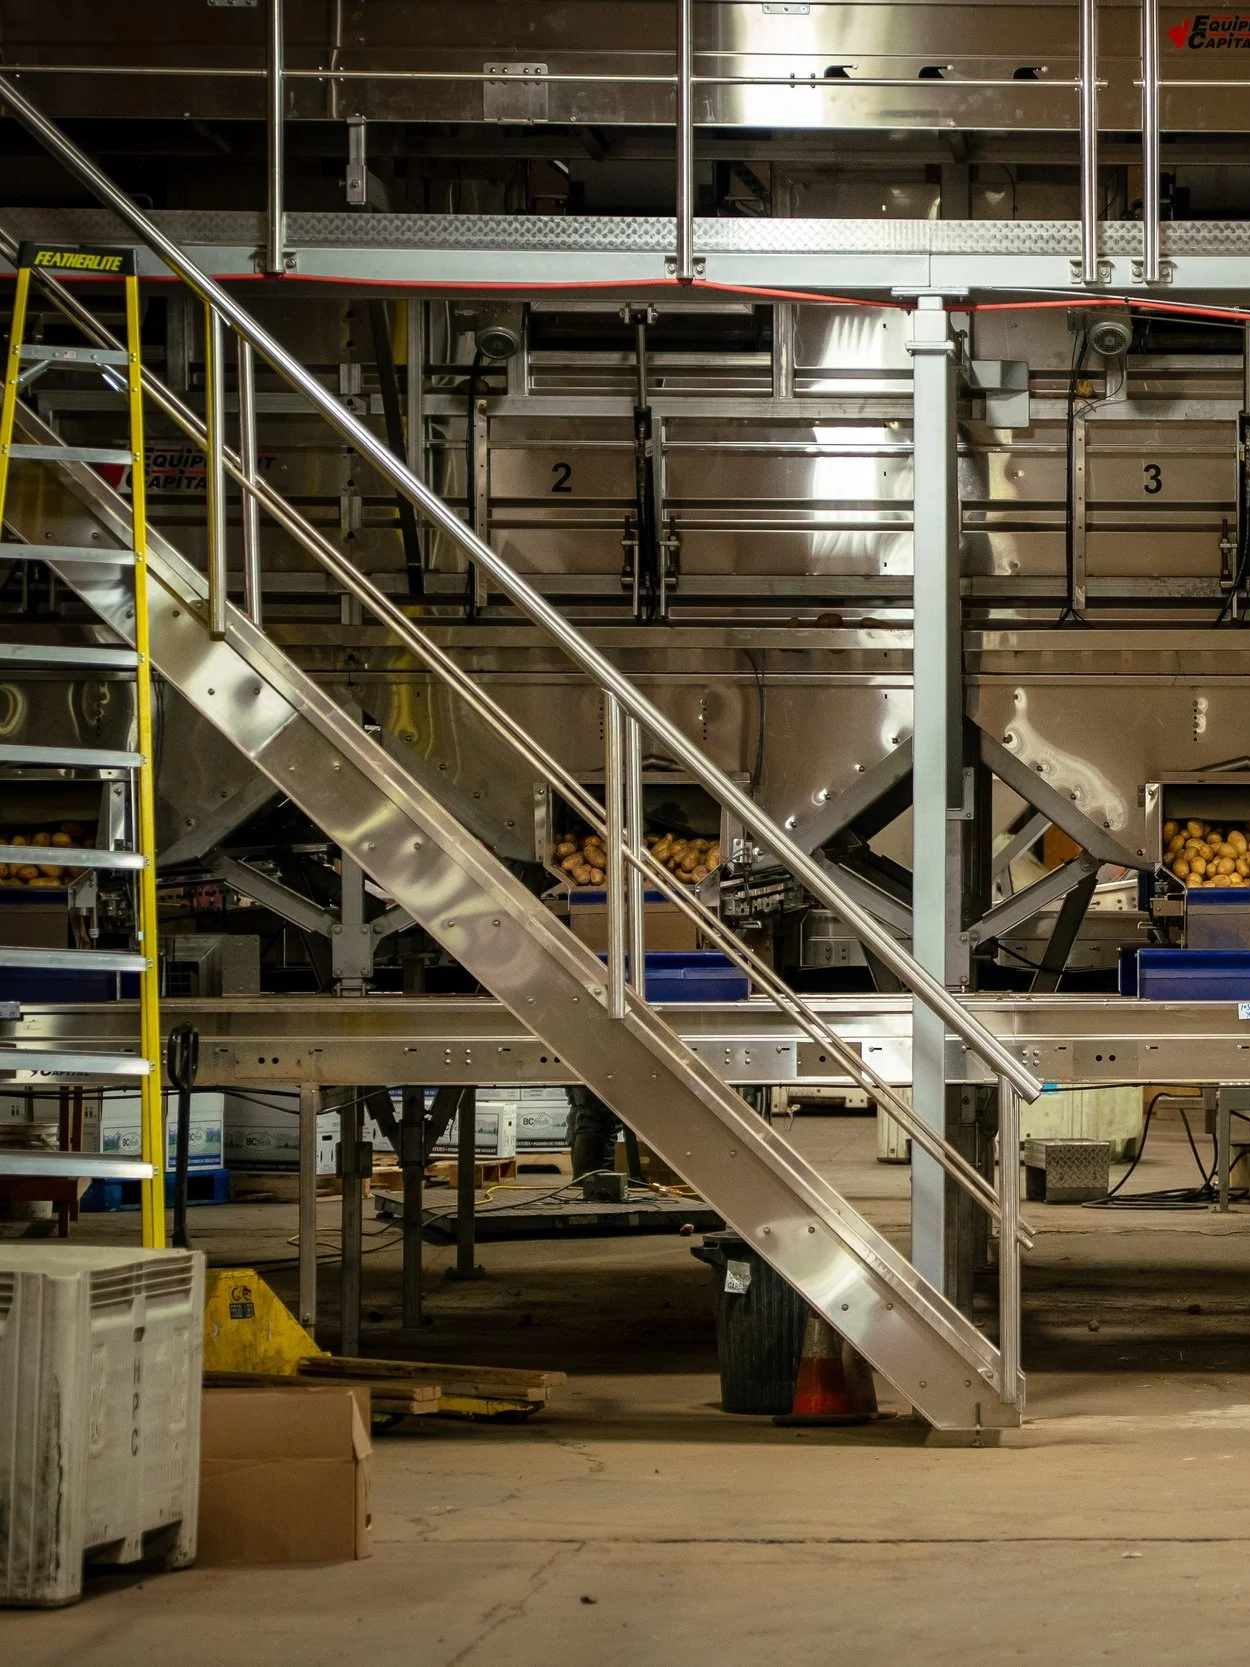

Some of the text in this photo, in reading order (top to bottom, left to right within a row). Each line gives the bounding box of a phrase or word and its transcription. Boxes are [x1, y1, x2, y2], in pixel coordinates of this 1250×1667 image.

[34, 251, 122, 271] FEATHERLITE
[552, 463, 571, 492] 2
[1144, 464, 1162, 494] 3
